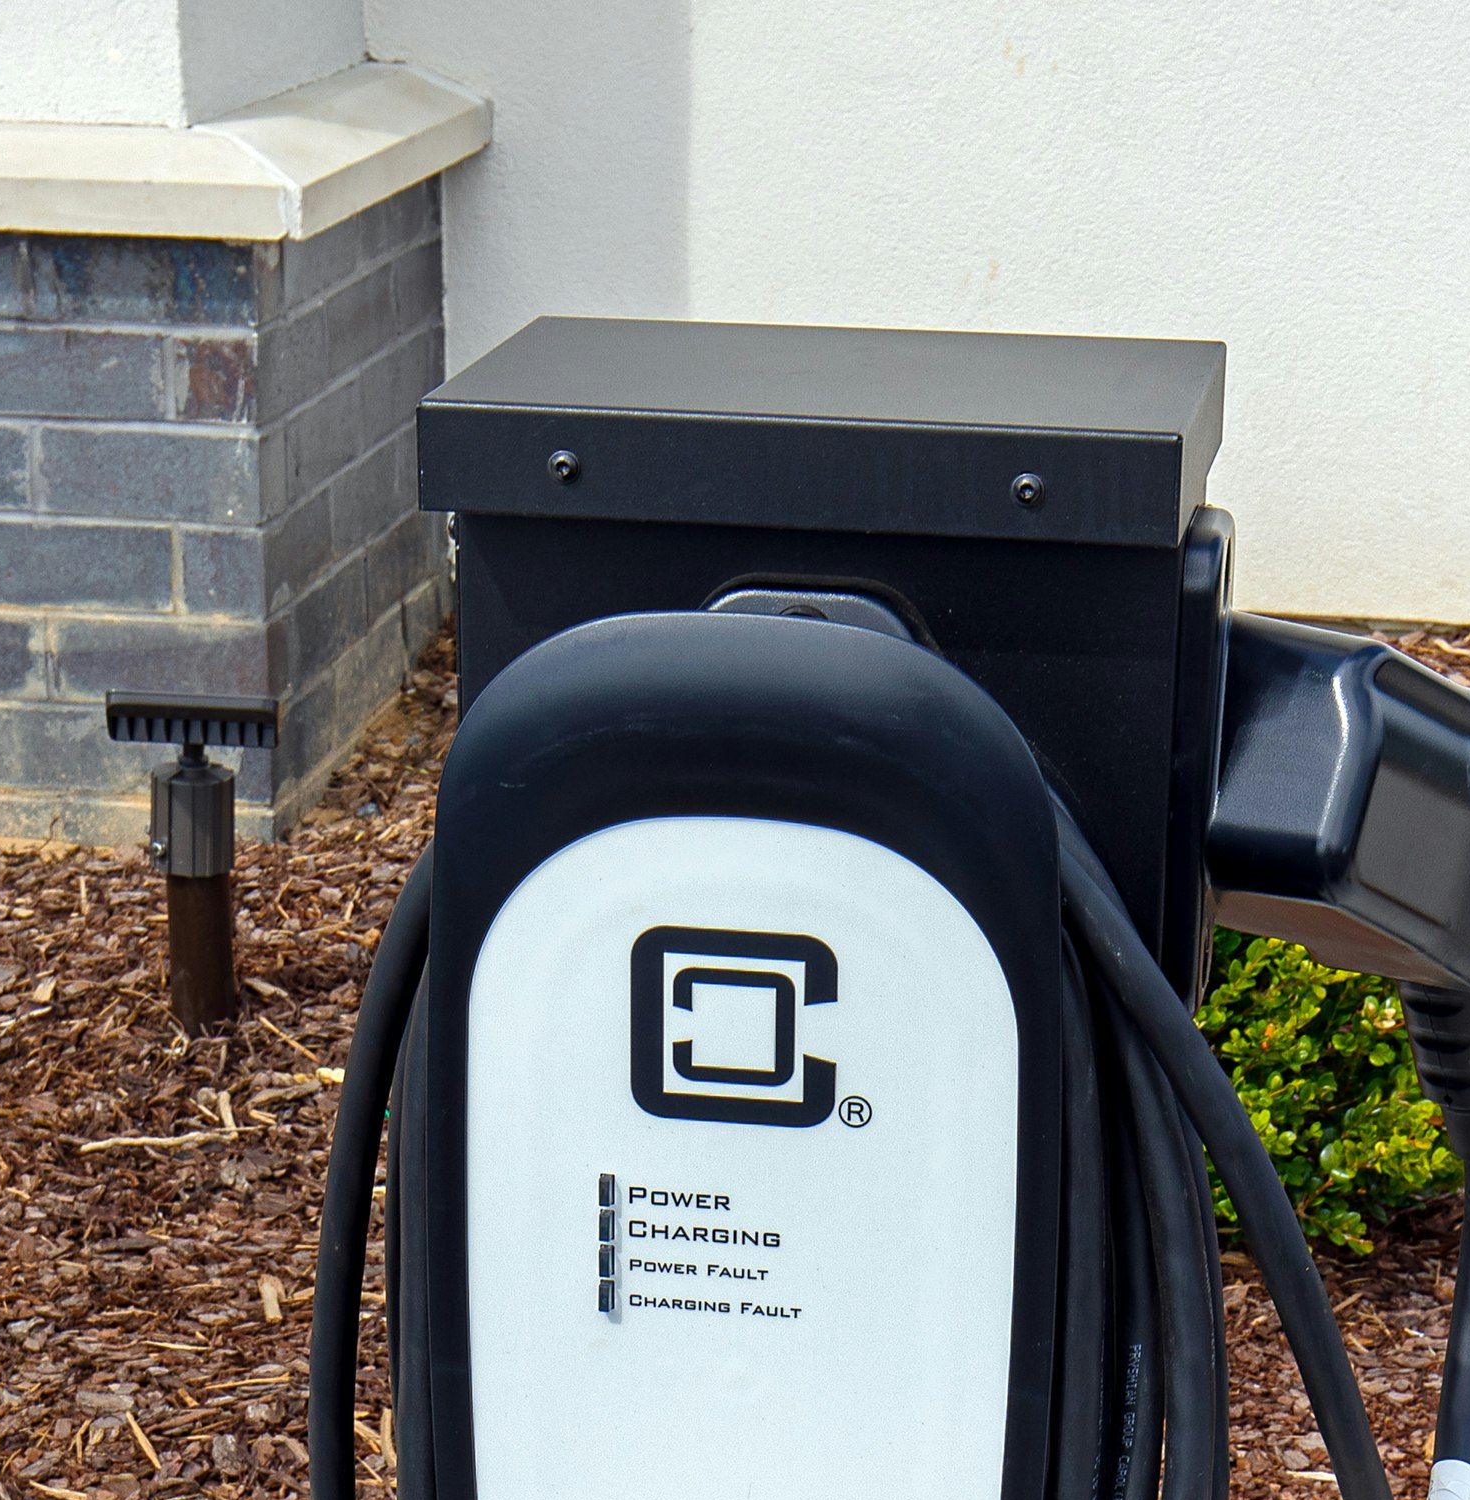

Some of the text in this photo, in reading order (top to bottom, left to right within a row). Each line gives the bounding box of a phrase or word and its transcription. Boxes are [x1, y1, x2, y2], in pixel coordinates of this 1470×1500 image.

[628, 1186, 732, 1212] POWER
[628, 1220, 782, 1249] CHARGING
[629, 1258, 770, 1282] POWER FAULT
[629, 1294, 803, 1320] CHARGING FAULT
[1121, 1411, 1136, 1449] GROUP
